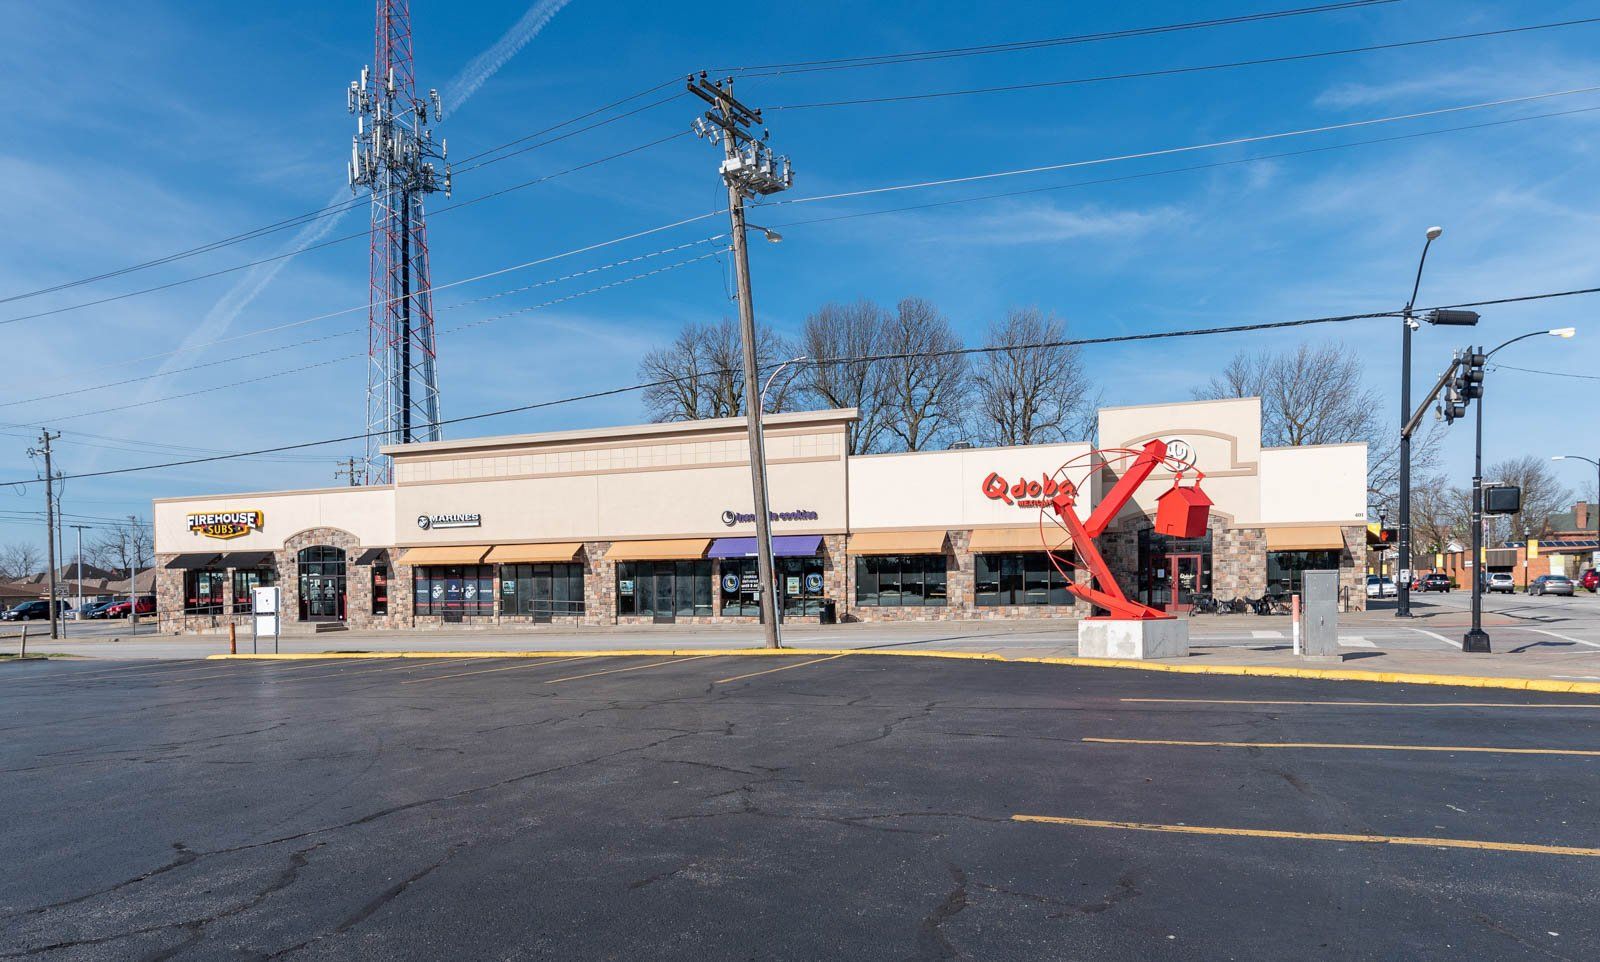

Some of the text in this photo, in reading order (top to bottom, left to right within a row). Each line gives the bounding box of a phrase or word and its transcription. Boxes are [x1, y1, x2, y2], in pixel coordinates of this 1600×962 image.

[982, 472, 1076, 505] Qdoba
[430, 513, 480, 523] MARINES
[779, 509, 818, 520] cookies
[187, 512, 255, 531] FIREHOUSE
[208, 525, 233, 534] SUBS
